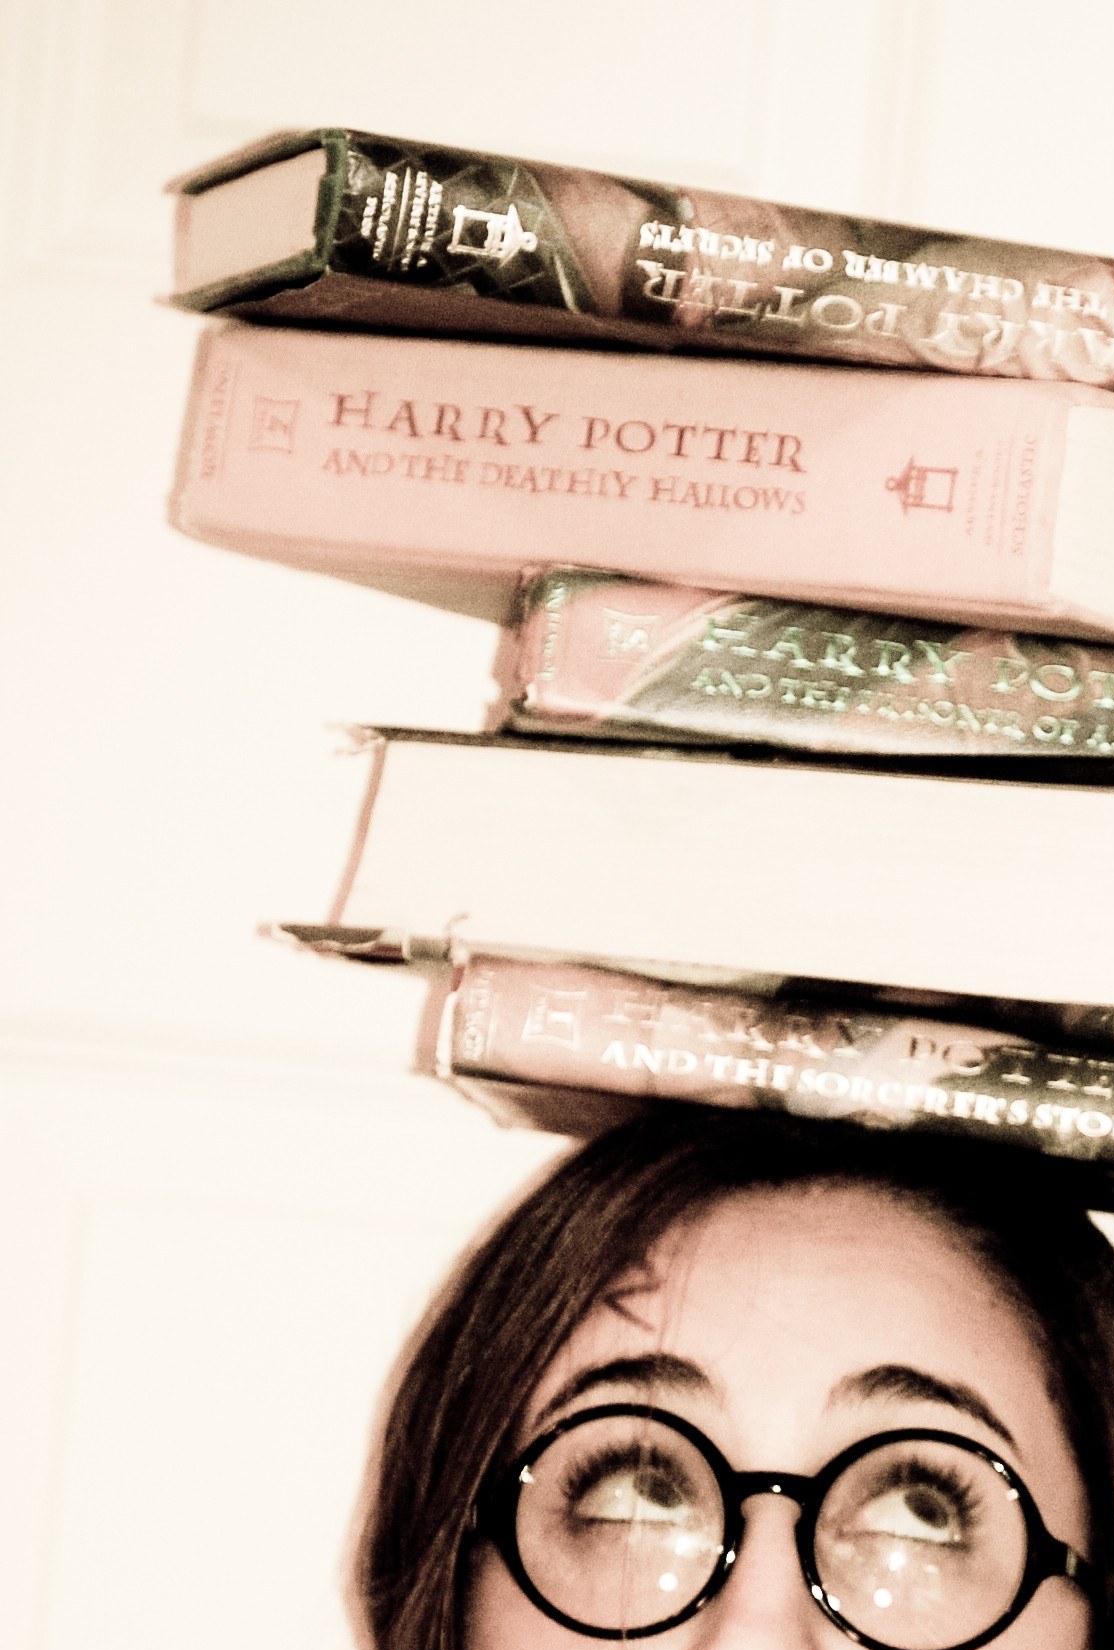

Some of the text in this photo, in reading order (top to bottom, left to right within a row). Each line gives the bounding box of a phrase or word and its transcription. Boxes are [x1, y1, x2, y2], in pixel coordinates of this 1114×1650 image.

[639, 220, 776, 266] SECRETS
[783, 244, 833, 273] OF
[636, 259, 907, 337] POTTER
[841, 249, 1025, 301] CHAMBER
[1031, 281, 1107, 318] THE
[328, 389, 806, 473] HARRY POTTER
[322, 446, 807, 516] AND THE DEATHLY HALLOWS
[697, 612, 972, 684] HARRY
[691, 667, 773, 700] AND
[601, 1039, 698, 1075] AND
[704, 1053, 795, 1091] THE
[797, 1067, 1028, 1126] SORCERER'S
